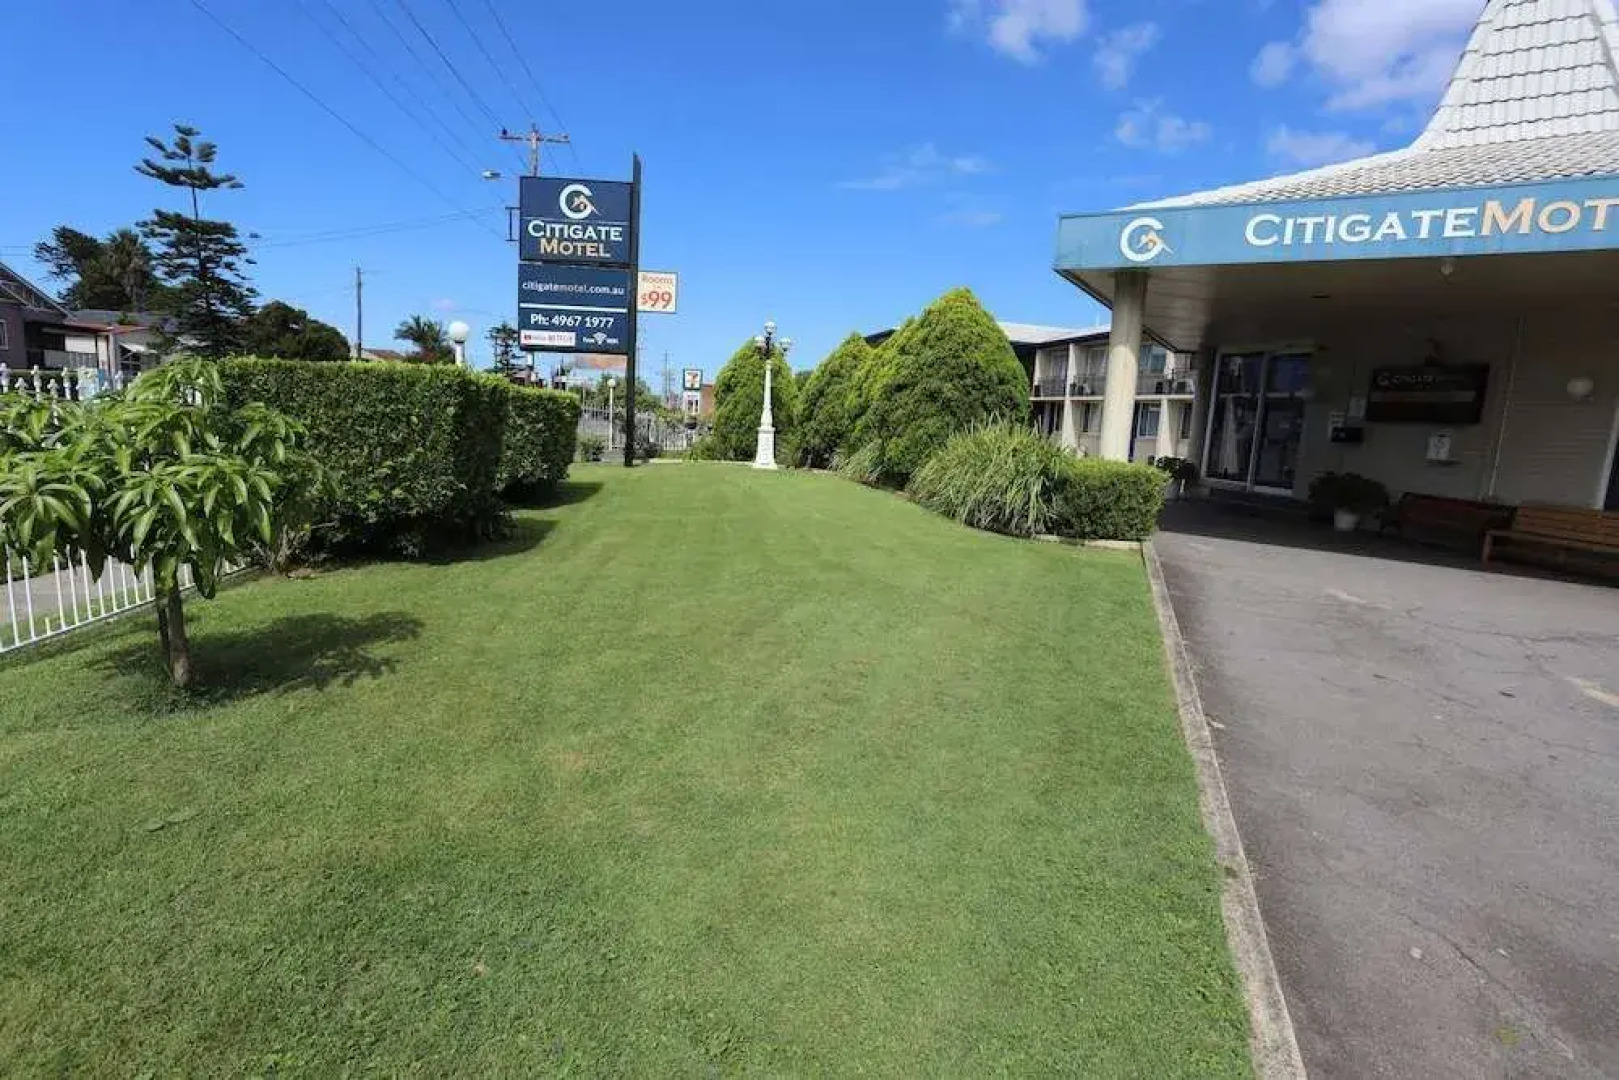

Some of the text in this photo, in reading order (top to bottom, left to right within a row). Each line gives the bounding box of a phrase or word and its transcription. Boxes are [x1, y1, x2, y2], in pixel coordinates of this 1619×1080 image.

[528, 219, 622, 241] CITIGATE
[540, 238, 611, 257] MOTEL
[522, 280, 625, 295] citigatemotel.com.au
[551, 315, 582, 328] 4967
[585, 316, 615, 328] 1977
